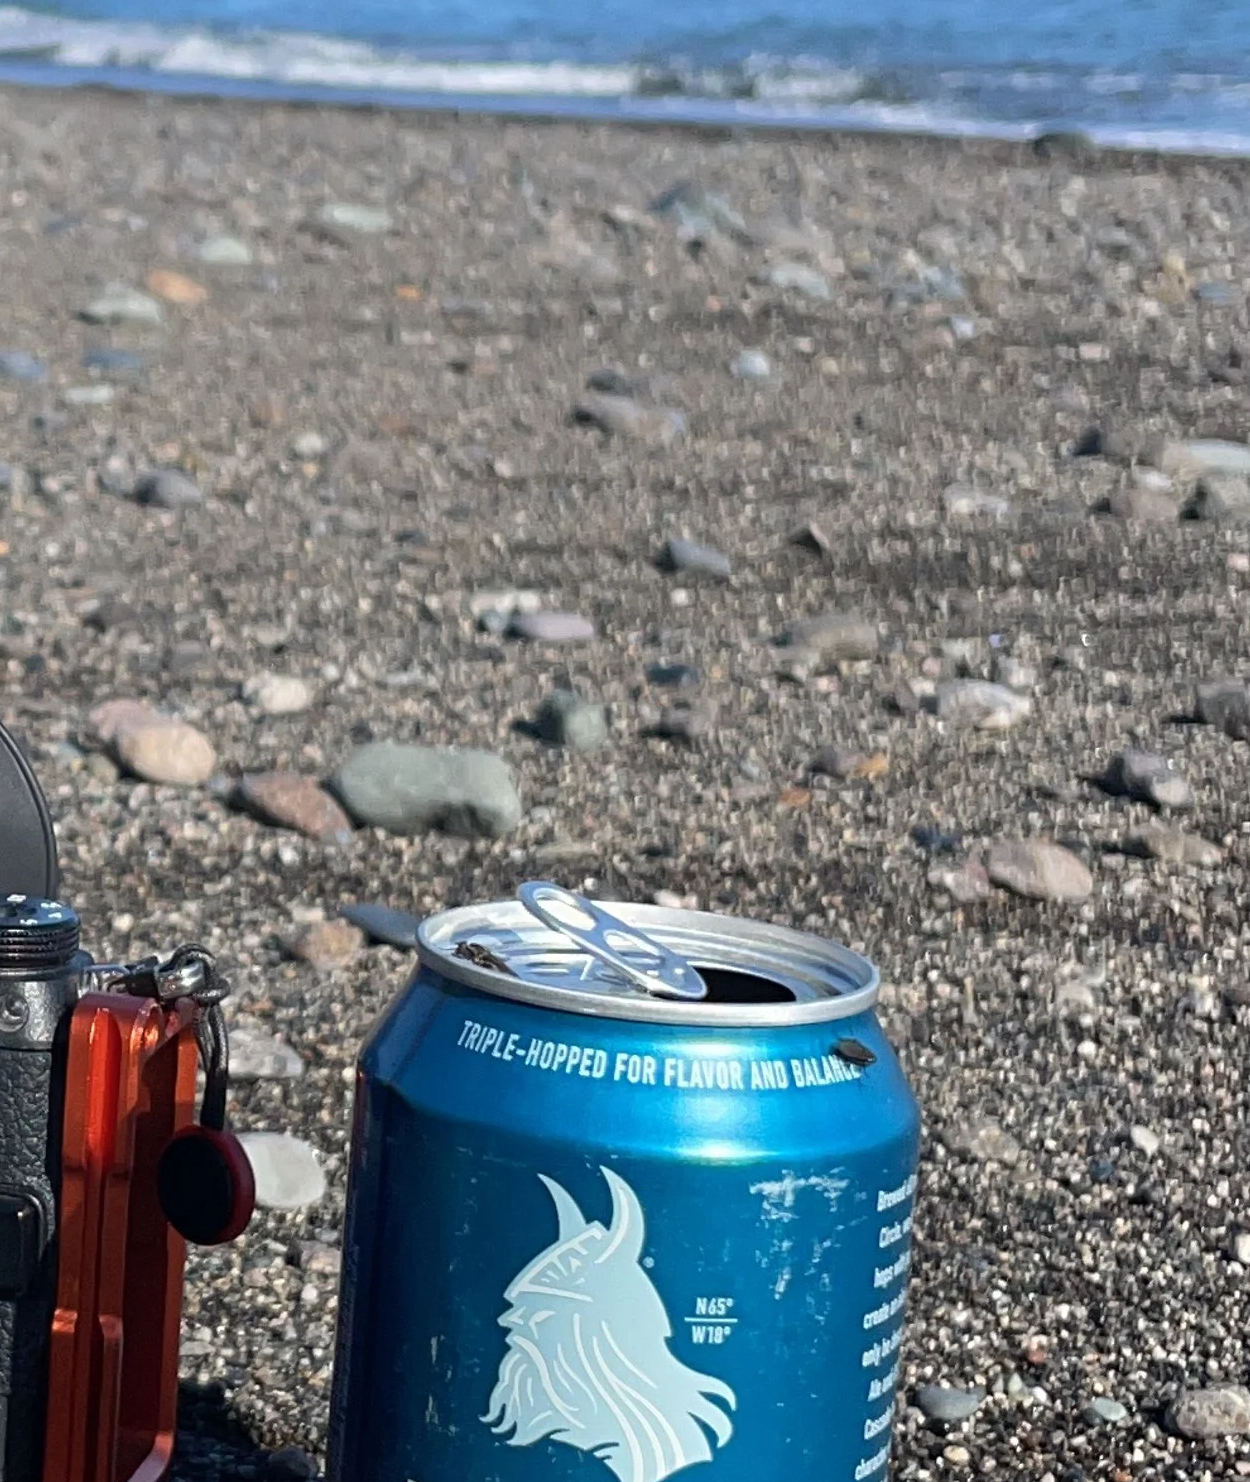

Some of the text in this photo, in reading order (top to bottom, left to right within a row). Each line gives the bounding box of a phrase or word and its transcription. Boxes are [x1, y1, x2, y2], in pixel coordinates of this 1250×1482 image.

[457, 1020, 607, 1078] TRIPLE-HOPPED
[613, 1053, 657, 1086] FOR
[664, 1058, 744, 1090] FLAVOR
[751, 1060, 789, 1090] AND
